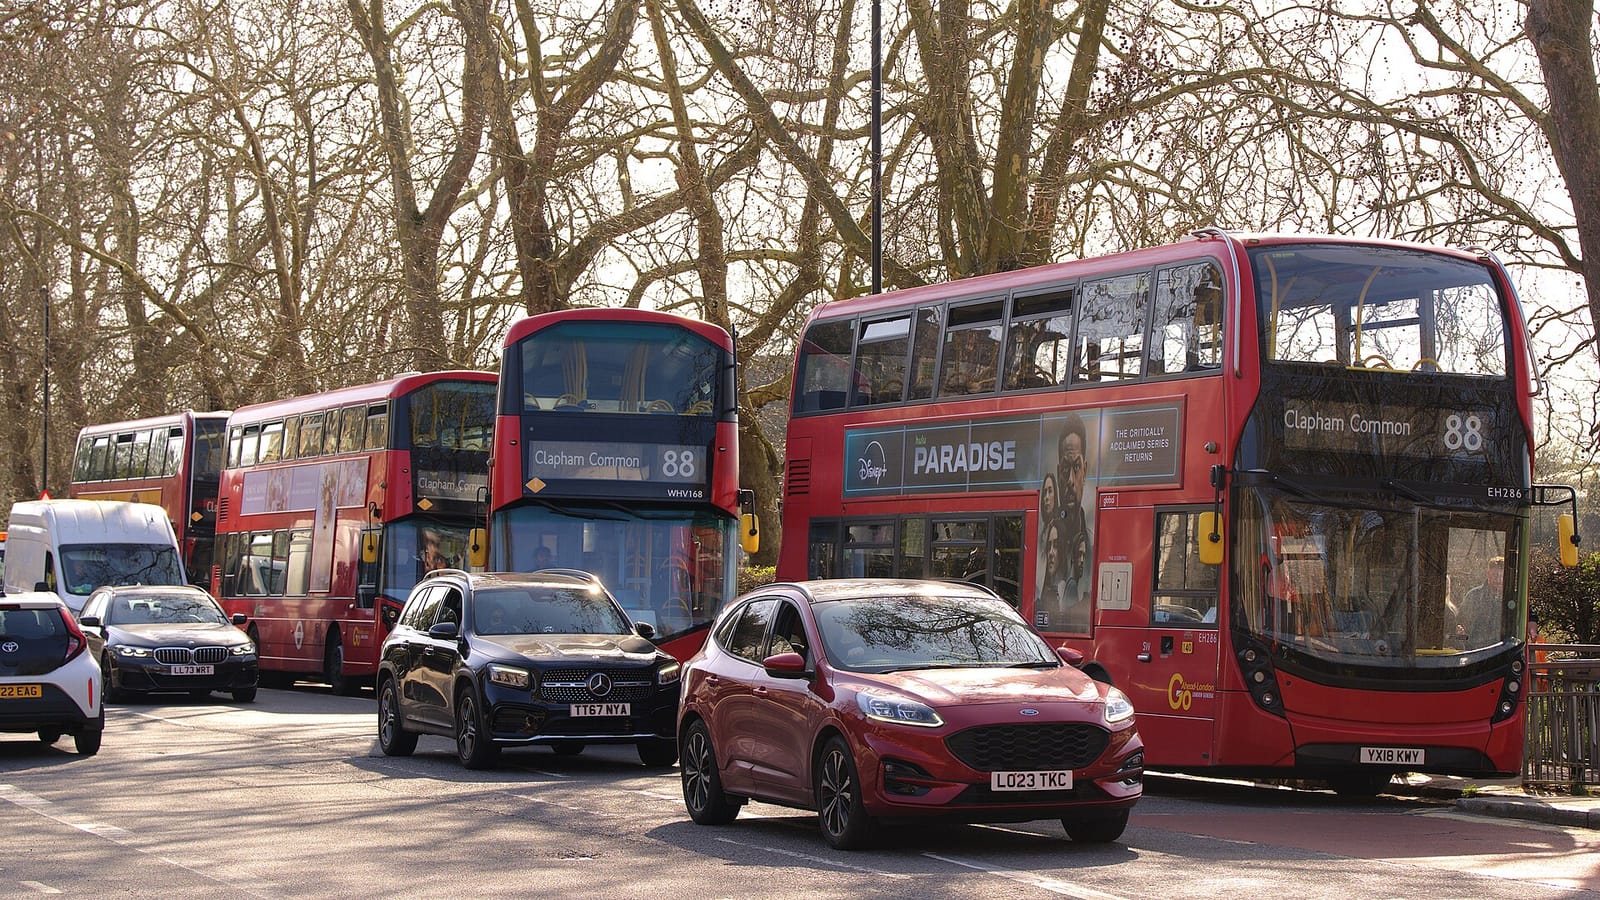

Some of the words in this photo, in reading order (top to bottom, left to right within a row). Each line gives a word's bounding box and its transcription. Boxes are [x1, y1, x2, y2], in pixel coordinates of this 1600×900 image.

[1284, 409, 1344, 434] Clapham
[1350, 413, 1411, 436] Common
[1116, 429, 1128, 438] THE
[1129, 427, 1165, 438] CRITICALLY
[1443, 414, 1483, 451] 88
[1110, 440, 1146, 450] ACCLAIMED
[1147, 438, 1169, 449] SERIES
[535, 450, 585, 469] Clapham
[588, 452, 640, 468] Common
[913, 440, 1016, 475] PARADISE
[1124, 452, 1153, 462] RETURNS
[662, 450, 695, 478] 88
[418, 477, 455, 492] Clapham
[457, 480, 487, 492] Comm
[667, 489, 703, 499] WHV168
[1487, 487, 1522, 499] EH286
[1198, 632, 1217, 644] EH286
[174, 666, 195, 675] LL73
[196, 665, 211, 675] WRT
[16, 686, 37, 697] EAG
[1168, 672, 1192, 711] Go
[575, 704, 603, 715] TT67
[606, 704, 627, 715] NYA
[1368, 749, 1394, 762] YX18
[1396, 750, 1419, 763] KWY
[997, 772, 1036, 788] LO23
[1039, 772, 1067, 788] TKC
